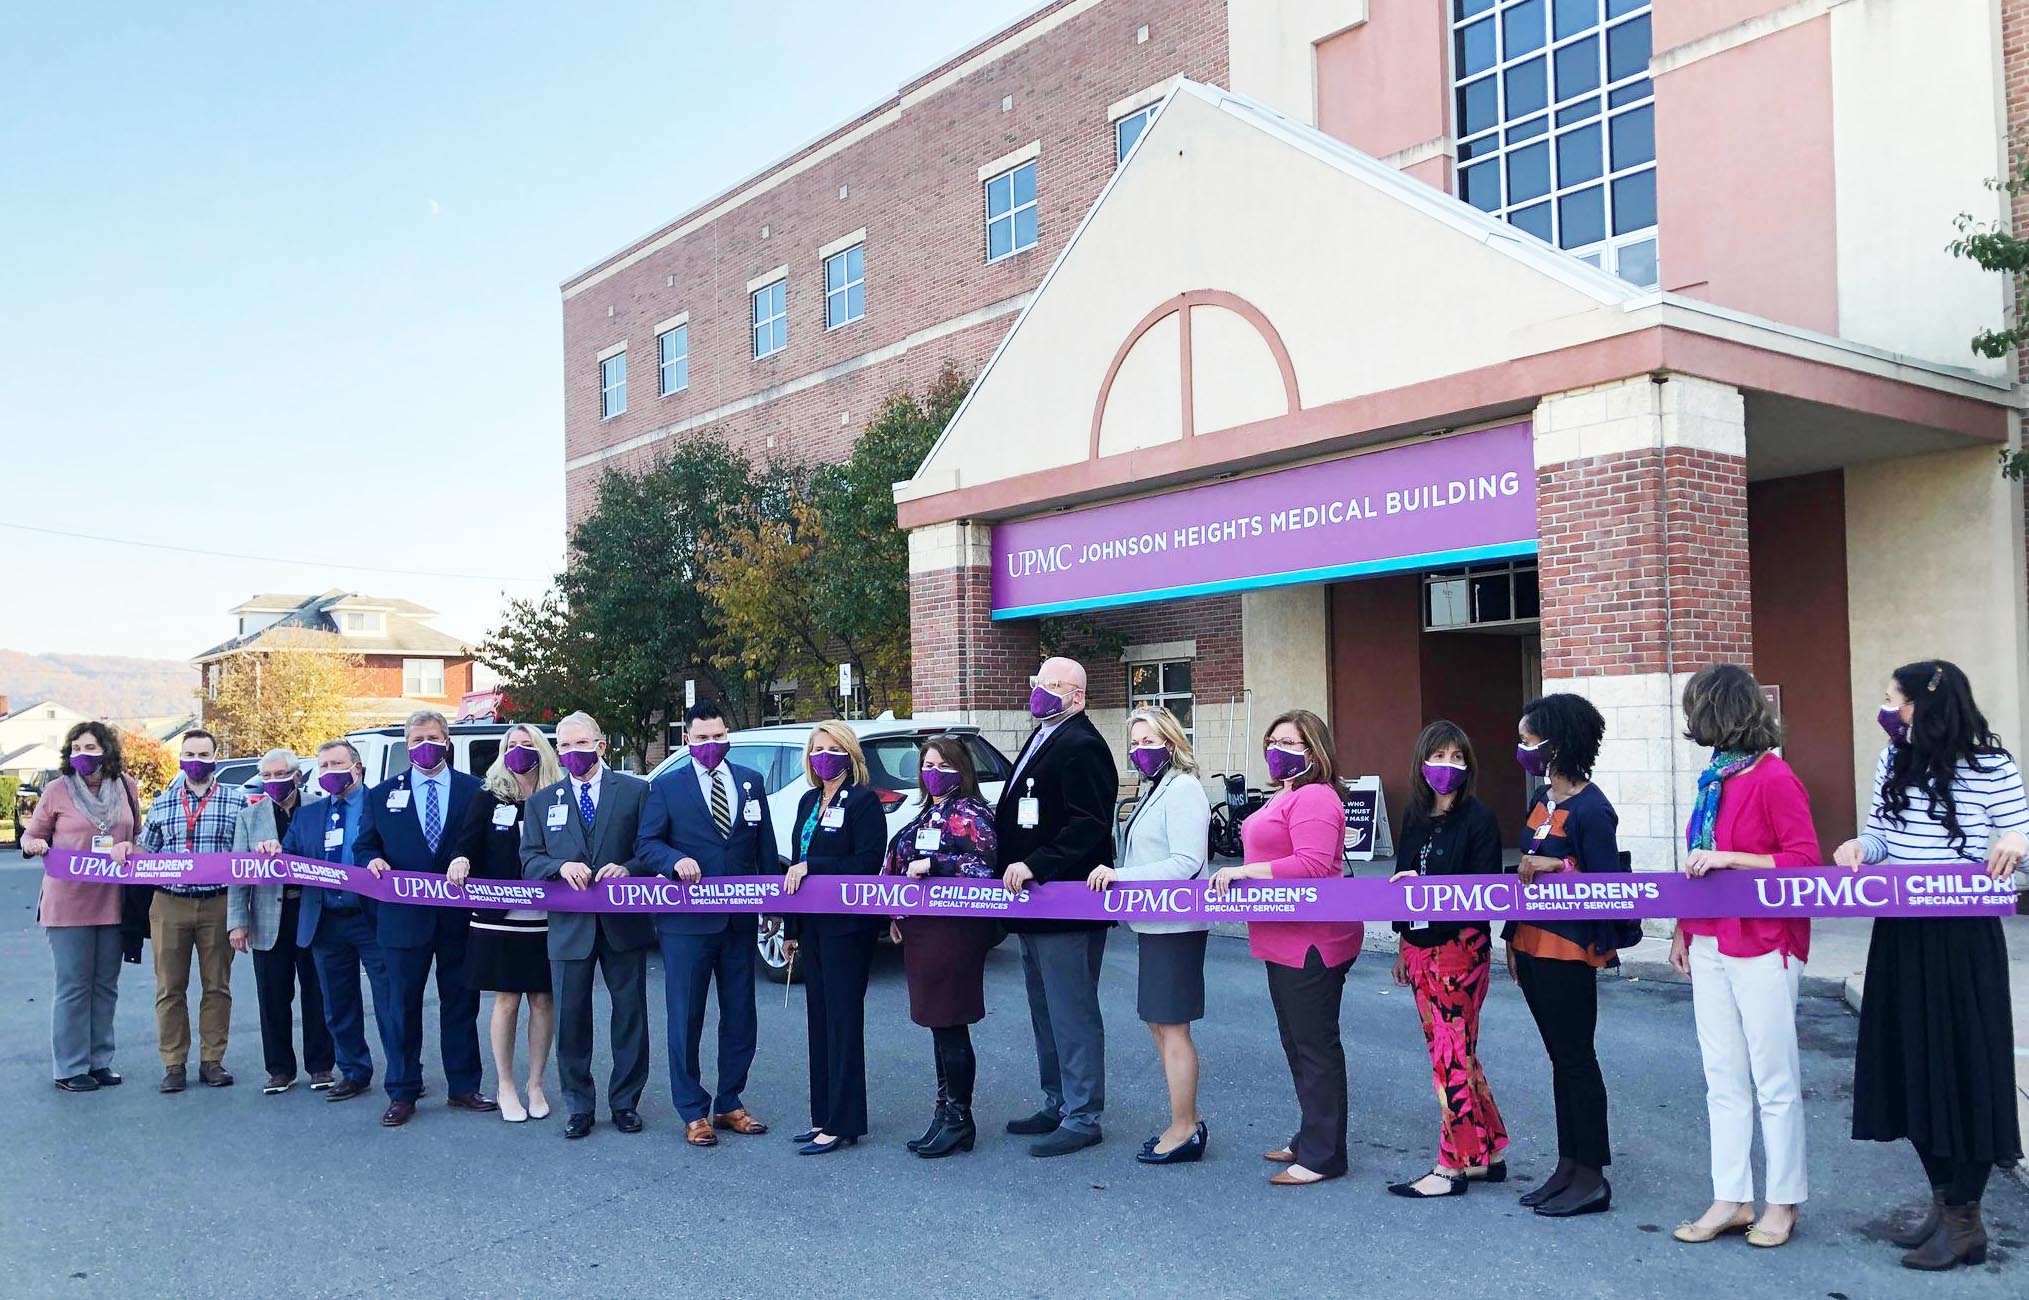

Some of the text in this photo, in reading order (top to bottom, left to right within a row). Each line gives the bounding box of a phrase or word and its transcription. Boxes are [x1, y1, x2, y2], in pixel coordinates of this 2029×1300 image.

[1007, 471, 1520, 579] UPMC JOHNSON HEIGHTS MEDICAL BUILDING
[70, 856, 130, 878] UPMC
[136, 859, 194, 871] CHILDREN'S
[231, 858, 288, 879] UPMC
[290, 861, 349, 881] CHILDREN'S
[392, 876, 460, 900] UPMC
[465, 883, 545, 899] CHILDREN'S
[689, 883, 780, 897] CHILDREN'S
[1523, 882, 1660, 900] CHILDREN'S
[1754, 875, 1890, 907] UPMC
[1905, 875, 2016, 893] CHILDR
[469, 895, 532, 905] SPECIALTY SERVICES
[607, 884, 681, 906] UPMC
[840, 882, 921, 908] UPMC
[929, 885, 1030, 903] CHILDREN'S
[1103, 887, 1193, 913] UPMC
[1203, 887, 1319, 903] CHILDREN'S
[1403, 883, 1511, 912] UPMC
[1908, 896, 1979, 906] SPECIALTY
[929, 900, 1010, 910] SPECIALTY SERVICES
[1204, 904, 1296, 912] SPECIALTY SERVICES
[1525, 901, 1635, 910] SPECIALTY SERVICES
